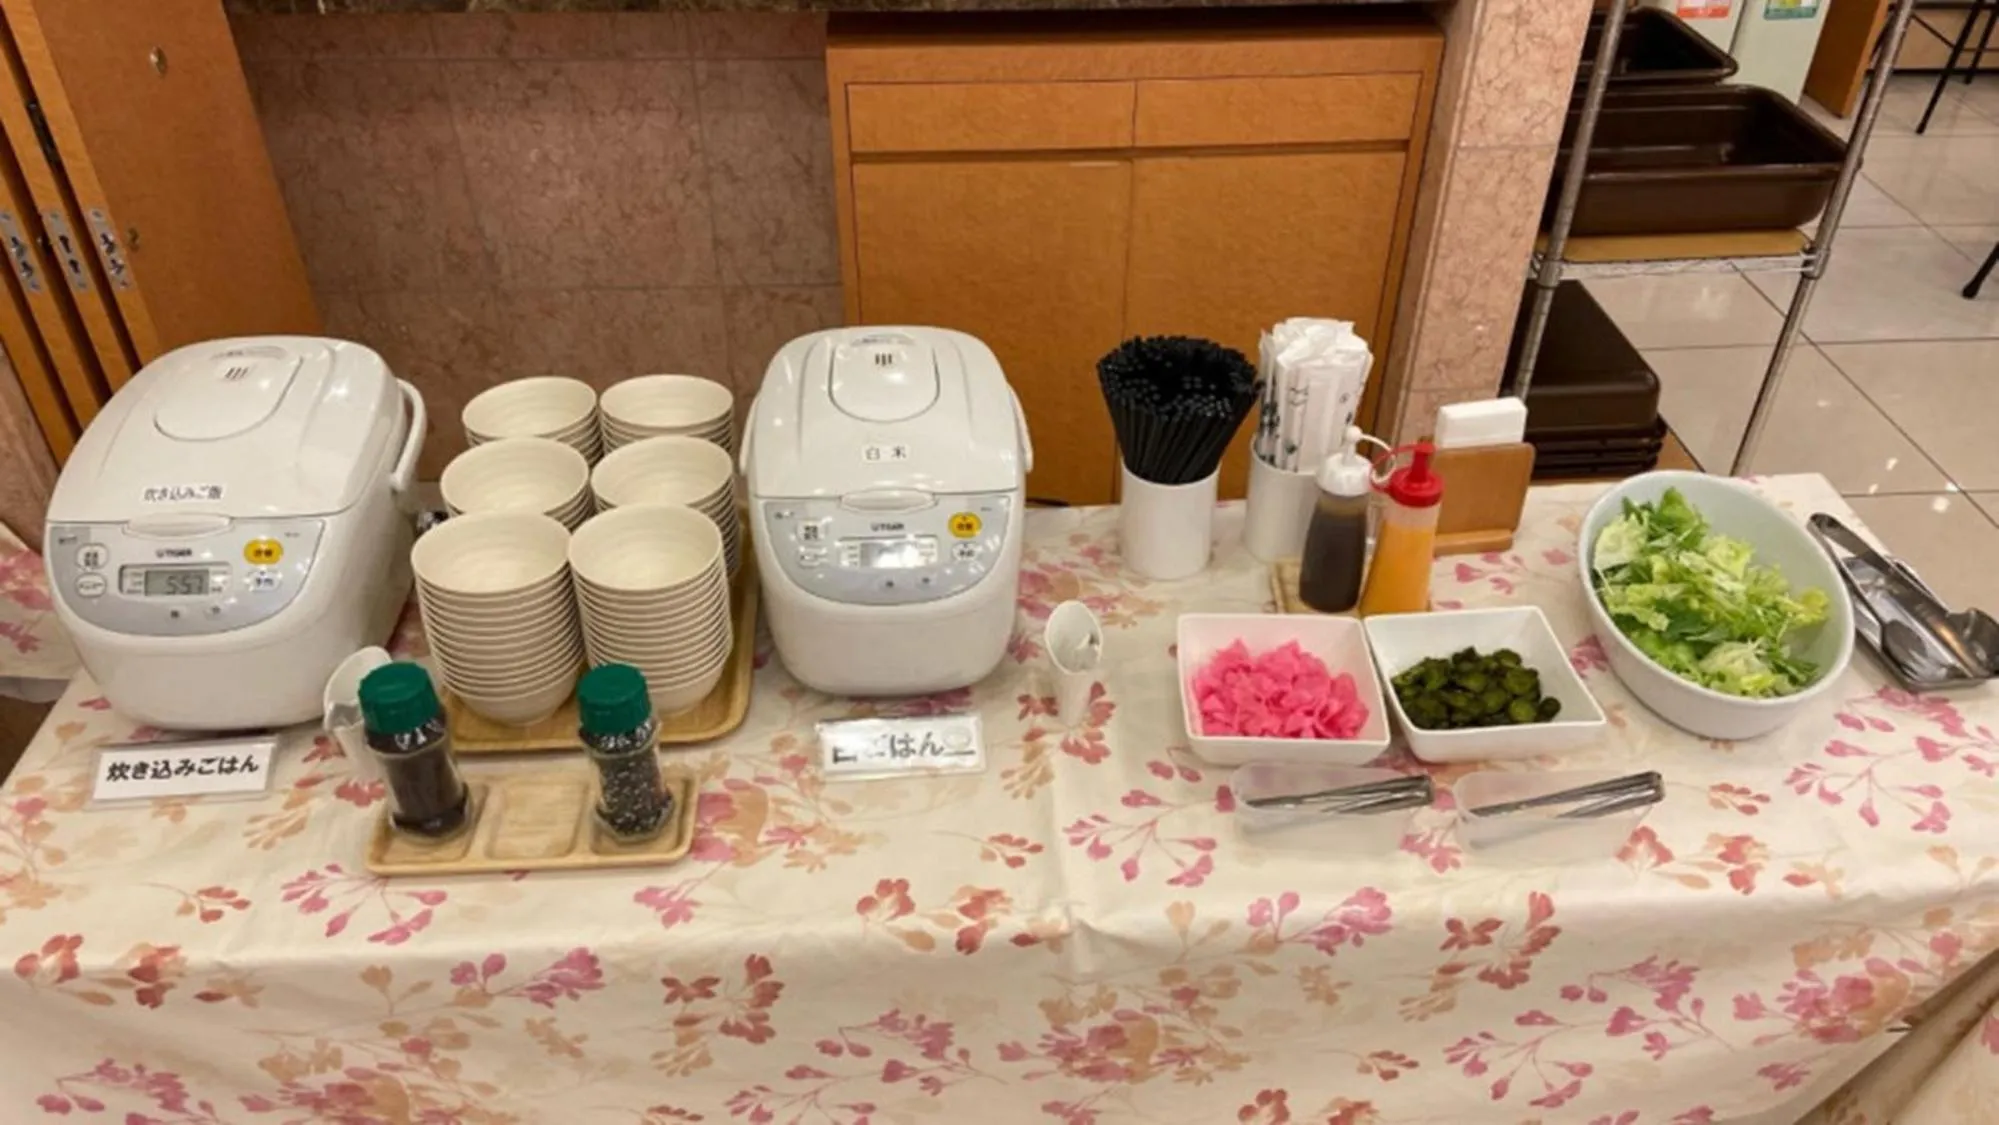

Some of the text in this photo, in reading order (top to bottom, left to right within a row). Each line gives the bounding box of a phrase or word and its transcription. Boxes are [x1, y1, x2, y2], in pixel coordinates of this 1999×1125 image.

[106, 754, 259, 783] 炊き込みごはん
